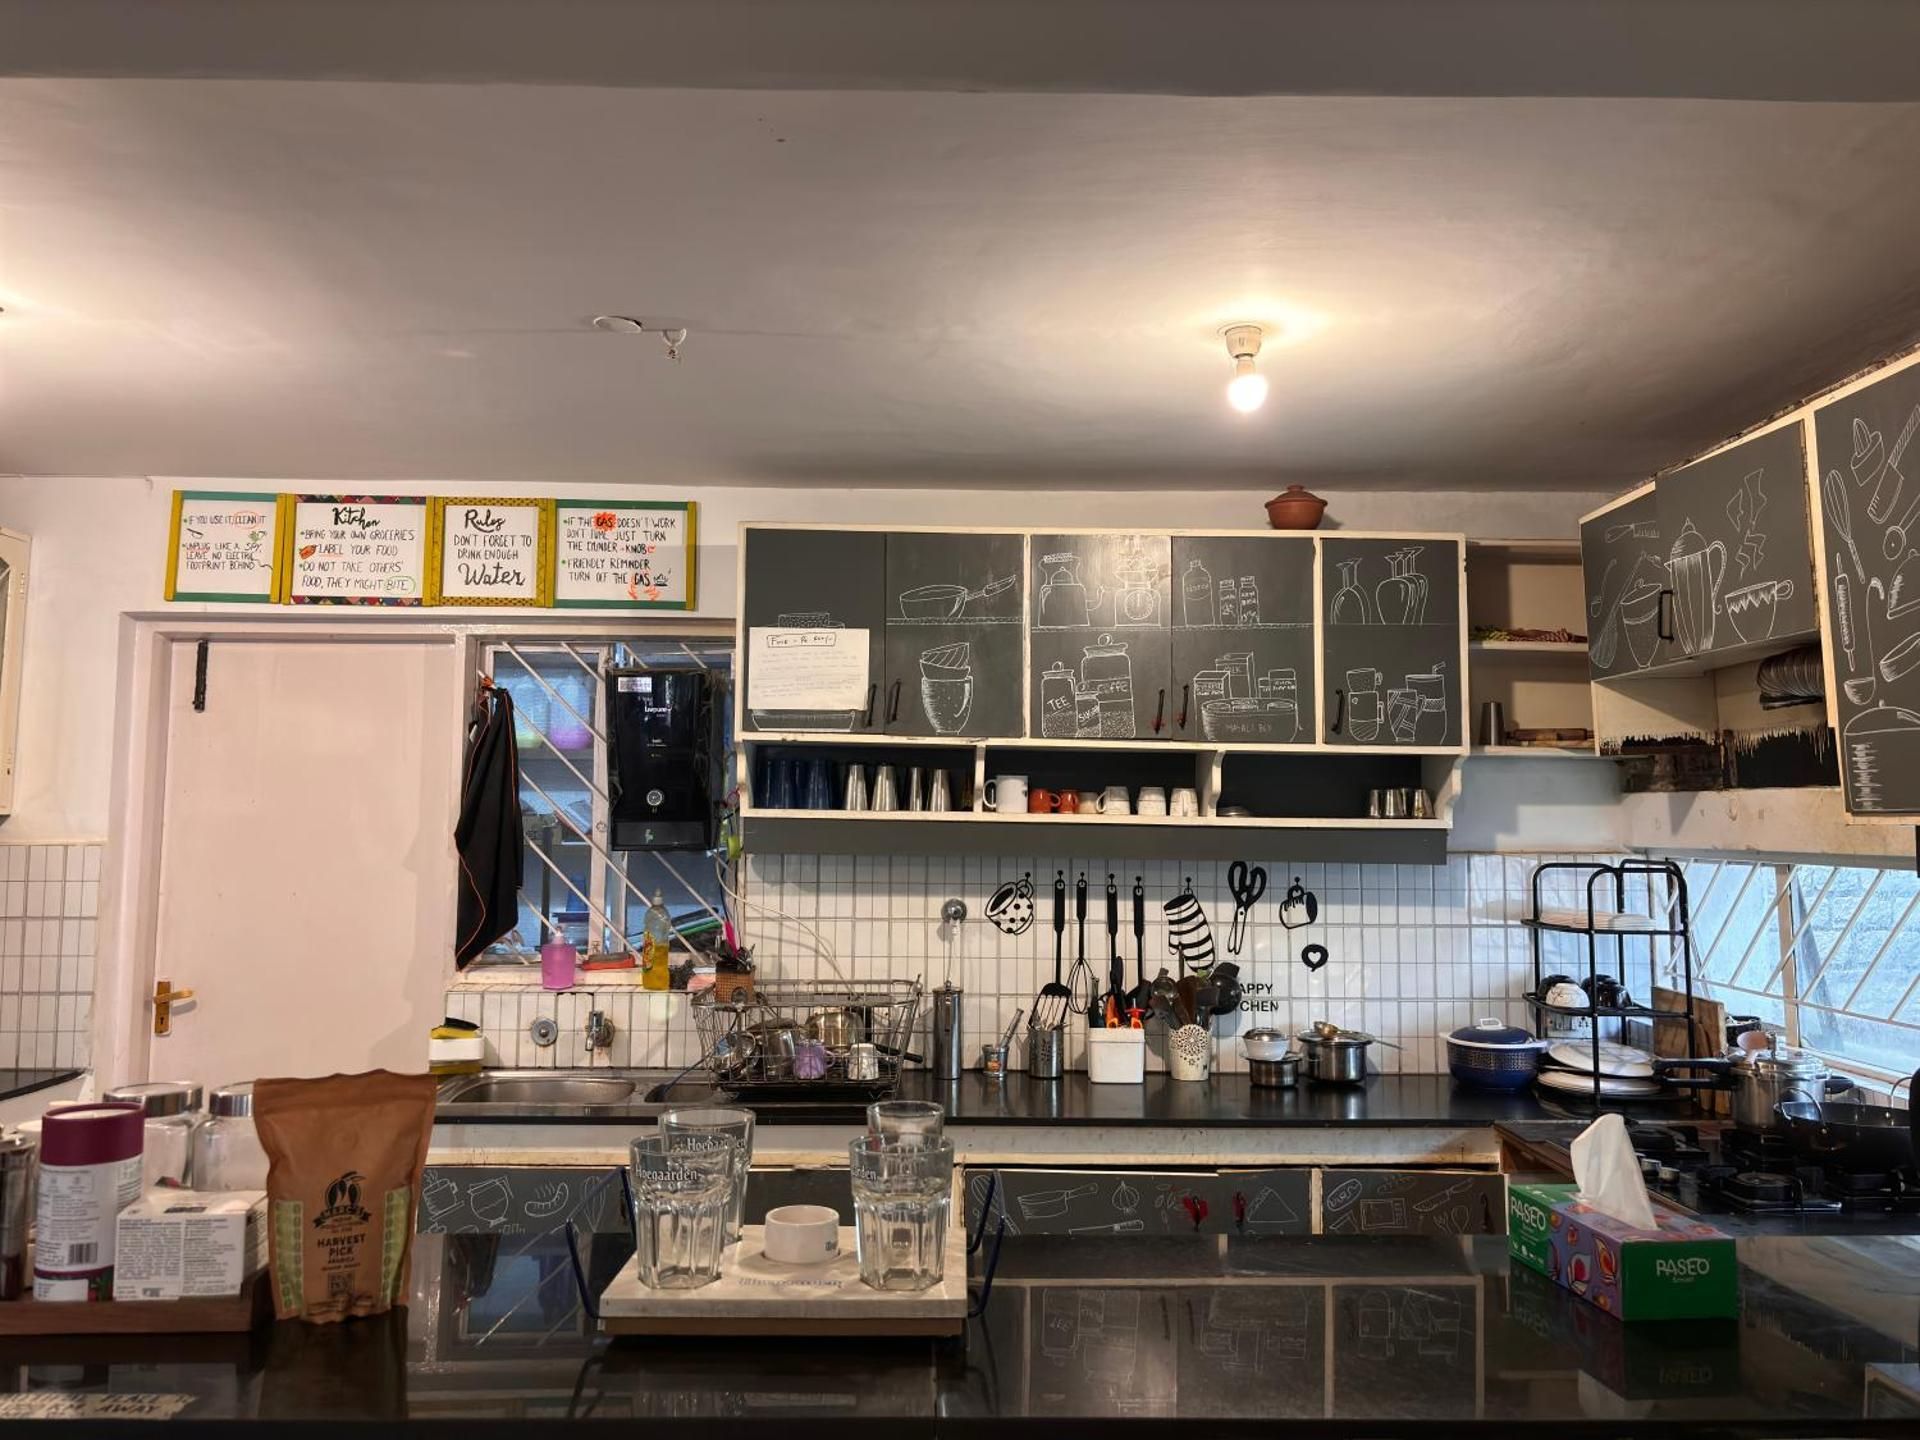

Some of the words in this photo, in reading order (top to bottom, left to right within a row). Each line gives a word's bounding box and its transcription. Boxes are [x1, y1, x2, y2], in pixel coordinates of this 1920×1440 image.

[196, 515, 208, 525] YOU
[209, 515, 224, 525] USE
[234, 515, 257, 525] CLEAN
[332, 506, 380, 530] Kitchen
[464, 508, 506, 533] Rules
[567, 516, 576, 527] IF
[596, 517, 614, 528] GAS
[651, 517, 677, 529] WORK
[304, 529, 326, 540] BRING
[329, 529, 346, 540] YOUR
[350, 529, 367, 540] OWN
[369, 529, 416, 541] GROCERIES
[453, 533, 479, 547] DON'T
[483, 534, 518, 548] FORGET
[520, 534, 533, 548] TO
[615, 530, 637, 542] JUST
[642, 530, 667, 542] TURN
[215, 542, 233, 551] LIKE
[319, 543, 344, 555] LABEL
[351, 545, 372, 556] YOUR
[376, 545, 399, 557] FOOD
[567, 540, 583, 552] THE
[186, 551, 209, 560] LEAVE
[212, 551, 222, 560] NO
[225, 551, 255, 561] ELECTRIC
[457, 548, 482, 561] DRINK
[484, 549, 520, 561] ENOUGH
[186, 561, 226, 571] FOOTPRINT
[229, 560, 256, 571] BEHIND
[303, 561, 315, 572] DO
[318, 561, 337, 572] NOT
[342, 561, 364, 573] TAKE
[567, 559, 606, 570] FRIENDLY
[610, 558, 651, 570] REMINDER
[457, 561, 526, 586] Water
[569, 571, 591, 582] TURN
[612, 572, 629, 585] THE
[634, 572, 651, 587] GAS
[326, 576, 352, 589] THEY
[354, 579, 384, 591] MIGHT
[386, 579, 409, 591] BITE
[1047, 695, 1071, 711] TEE
[1240, 983, 1273, 995] APPY
[1240, 1000, 1280, 1012] CHEN
[635, 1164, 697, 1181] Hoegaarden
[1510, 1195, 1546, 1231] PASEO
[317, 1233, 366, 1248] HARVEST
[328, 1247, 354, 1257] PICK
[1656, 1257, 1710, 1277] PASEO
